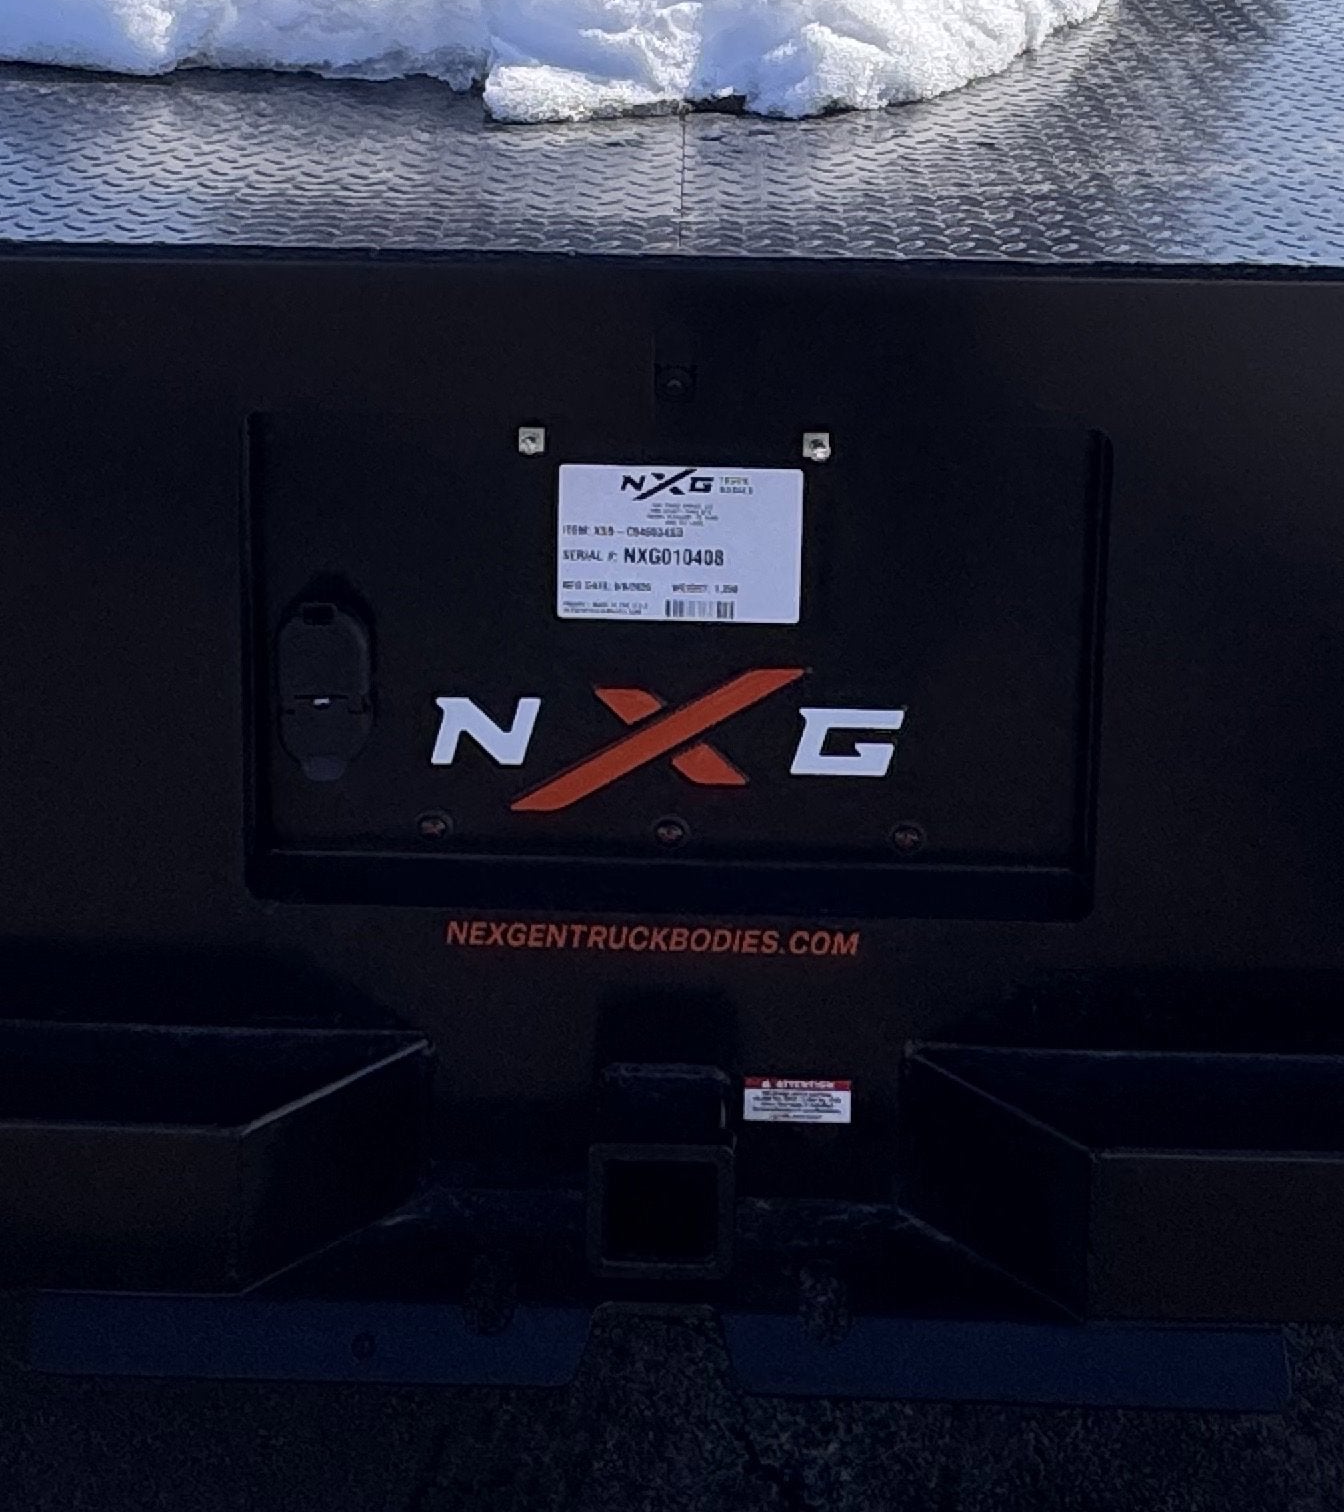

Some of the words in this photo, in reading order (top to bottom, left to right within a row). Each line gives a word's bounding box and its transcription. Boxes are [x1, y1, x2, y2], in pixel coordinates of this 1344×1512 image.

[620, 468, 715, 501] NXG
[562, 549, 603, 562] SERIAL
[624, 547, 724, 566] NXG010408
[431, 669, 905, 811] NXG
[445, 919, 860, 957] NEXGENTRUCKBODIES.COM
